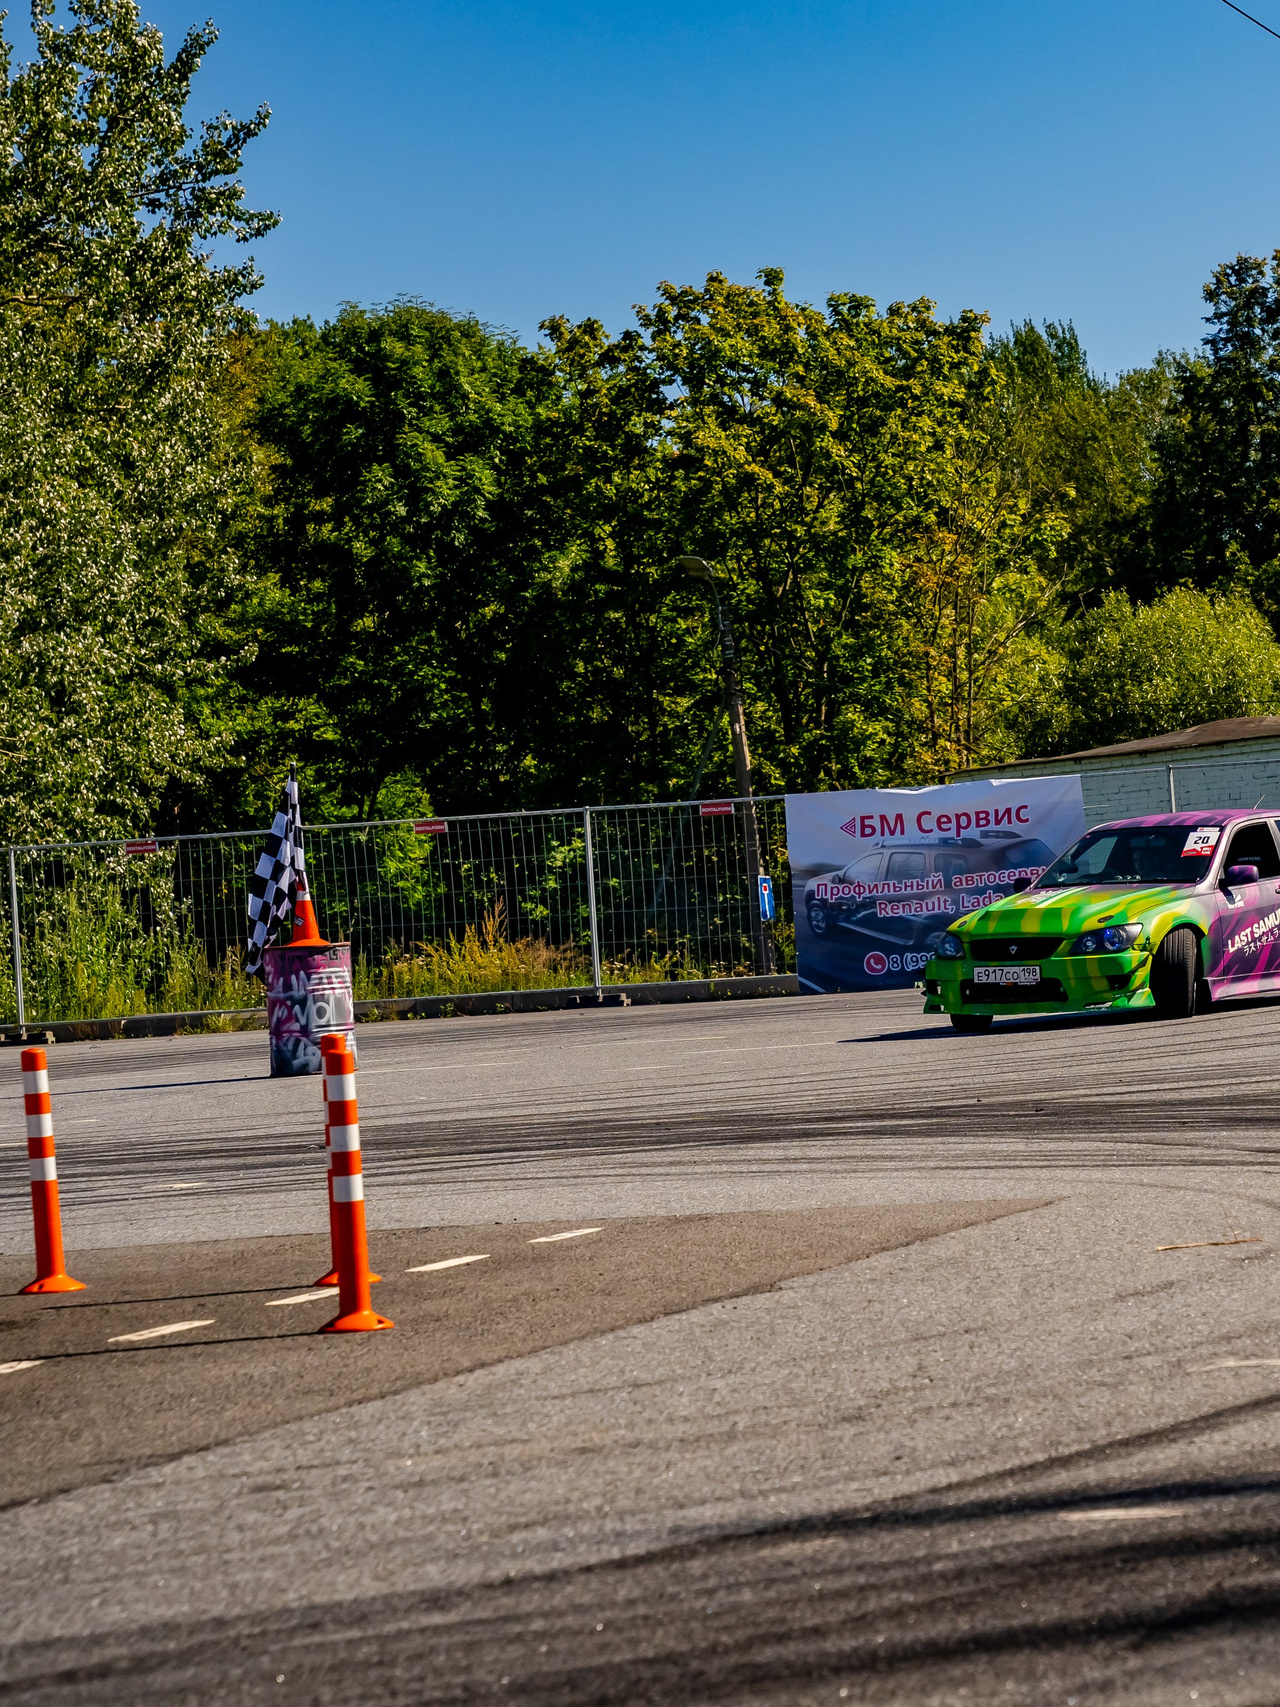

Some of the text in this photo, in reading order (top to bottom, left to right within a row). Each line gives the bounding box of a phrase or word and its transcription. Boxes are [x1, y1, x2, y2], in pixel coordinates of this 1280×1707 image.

[859, 804, 1031, 839] БМ Сервис
[1193, 835, 1211, 845] 20
[815, 873, 944, 902] Профильный
[876, 896, 955, 917] Renault,
[1227, 927, 1252, 953] LAST
[889, 955, 901, 971] 8
[1021, 967, 1037, 978] 198
